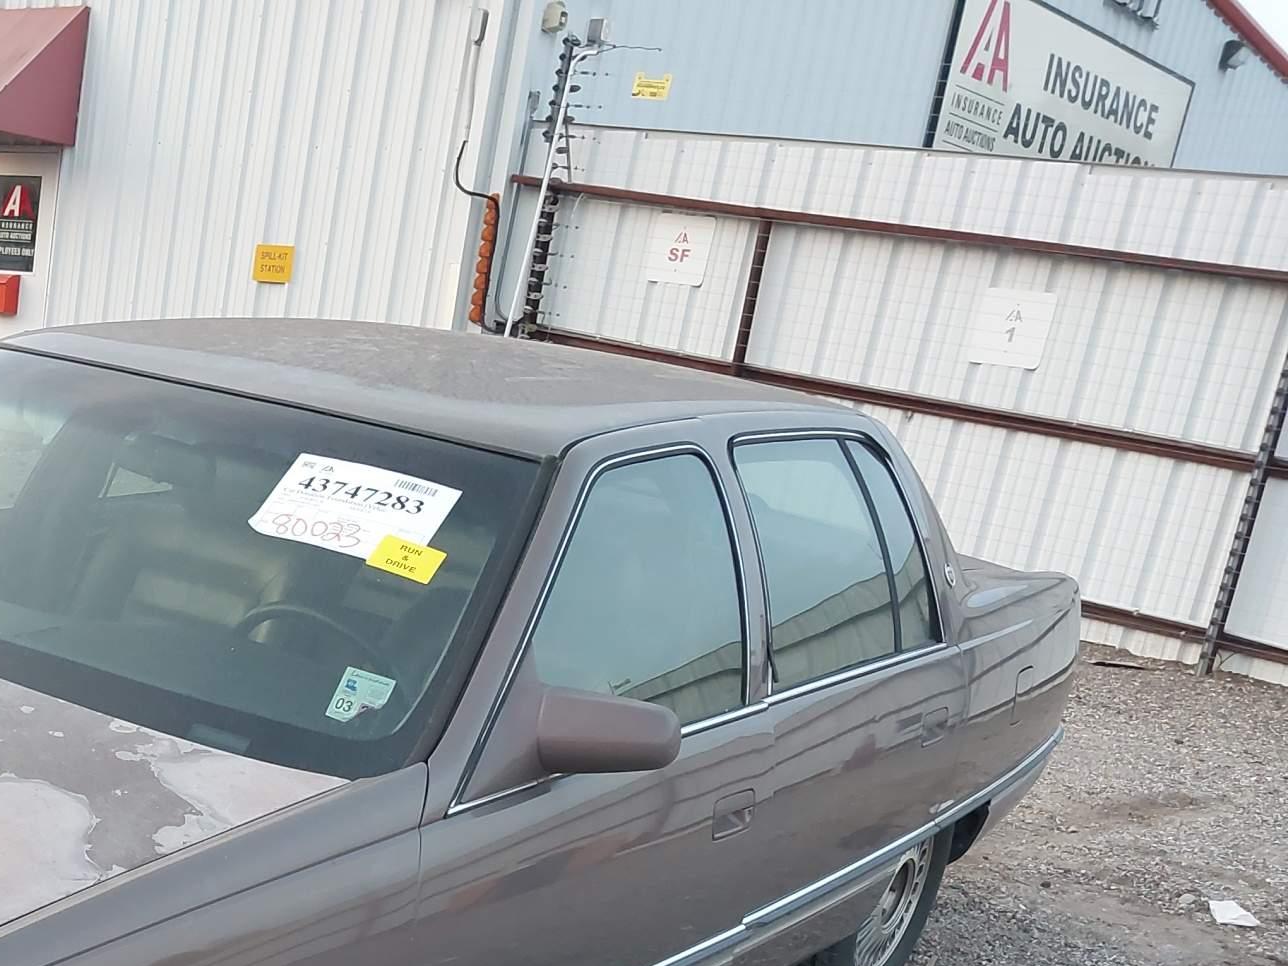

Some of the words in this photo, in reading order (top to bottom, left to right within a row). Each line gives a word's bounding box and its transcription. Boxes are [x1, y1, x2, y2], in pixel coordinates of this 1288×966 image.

[1043, 53, 1160, 140] INSURANCE
[951, 92, 1003, 126] INSURANCE
[944, 119, 965, 141] AUTO
[963, 125, 997, 152] AUCTIONS
[1003, 103, 1068, 159] AUTO
[0, 221, 33, 231] INSURANCE
[21, 248, 34, 257] ONLY
[668, 247, 692, 263] SF
[260, 264, 286, 274] STATION
[1005, 326, 1016, 343] 1
[298, 476, 426, 516] 43747283
[272, 513, 362, 548] 80023
[399, 543, 424, 557] RUN
[385, 557, 418, 574] DRIVE
[335, 697, 354, 713] 03
